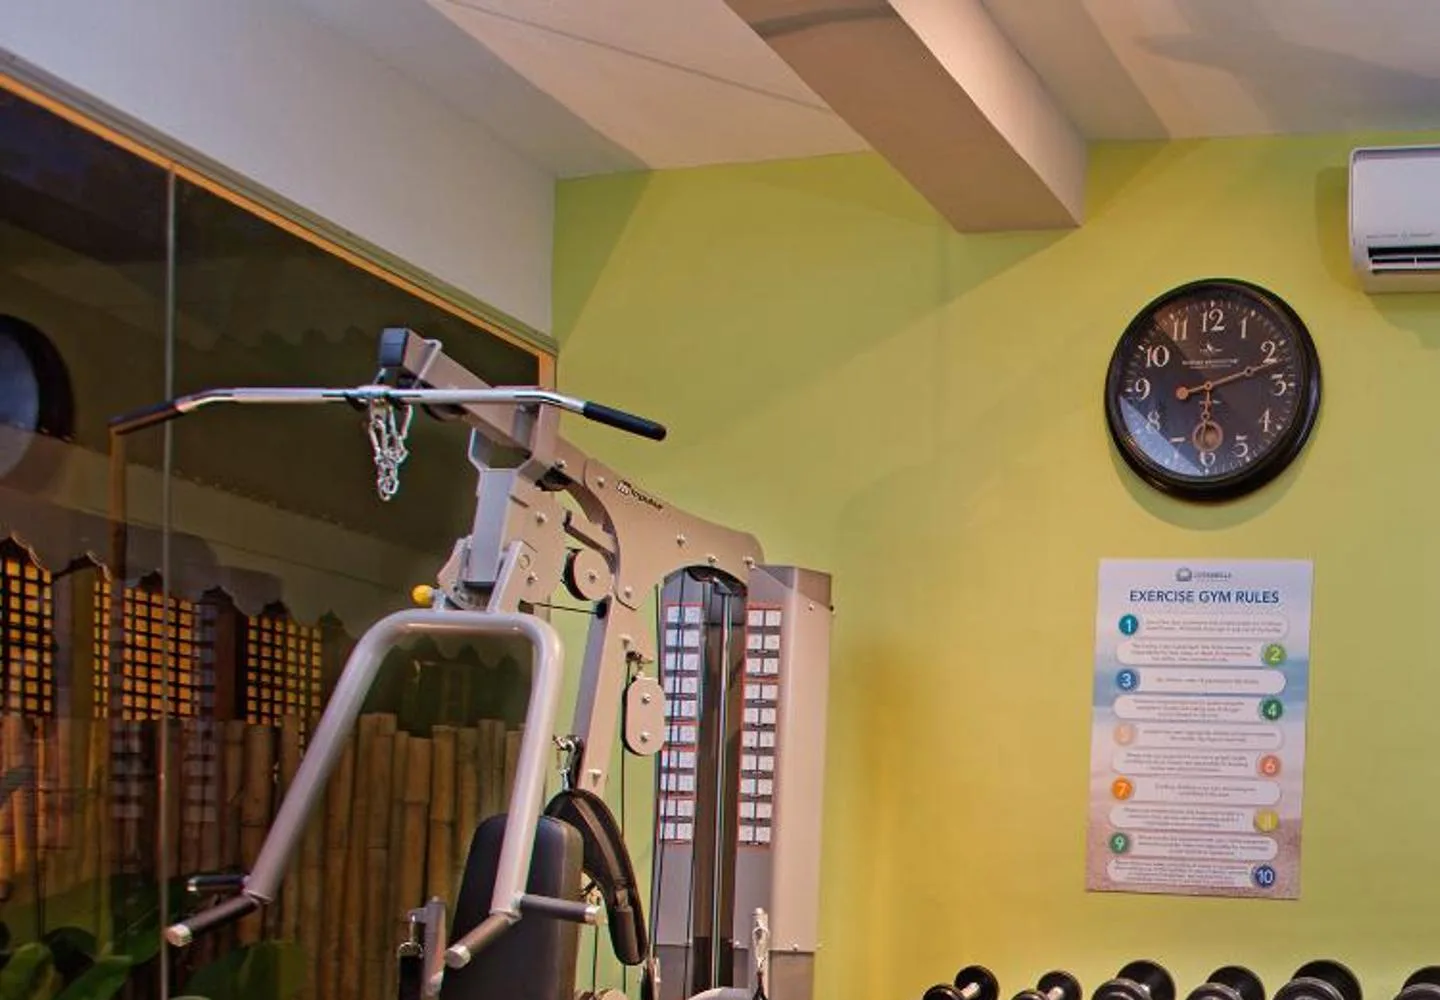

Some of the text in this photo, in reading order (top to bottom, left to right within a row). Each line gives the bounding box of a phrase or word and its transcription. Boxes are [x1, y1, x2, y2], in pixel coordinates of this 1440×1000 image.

[1172, 314, 1189, 341] 11
[1202, 309, 1225, 332] 12
[1240, 316, 1248, 339] 1
[1145, 345, 1170, 368] 10
[1260, 341, 1278, 364] 2
[1135, 378, 1151, 400] 9
[1271, 374, 1287, 396] 3
[1258, 408, 1272, 432] 4
[1236, 435, 1249, 457] 5
[1129, 590, 1280, 604] EXERCISE GYM RULES
[1124, 618, 1132, 633] 1
[1269, 647, 1281, 661] 2
[1122, 673, 1132, 687] 3
[1267, 703, 1277, 717] 4
[1264, 757, 1275, 772] 6
[1117, 782, 1127, 797] 7
[1114, 836, 1124, 850] 9
[1258, 869, 1274, 884] 10
